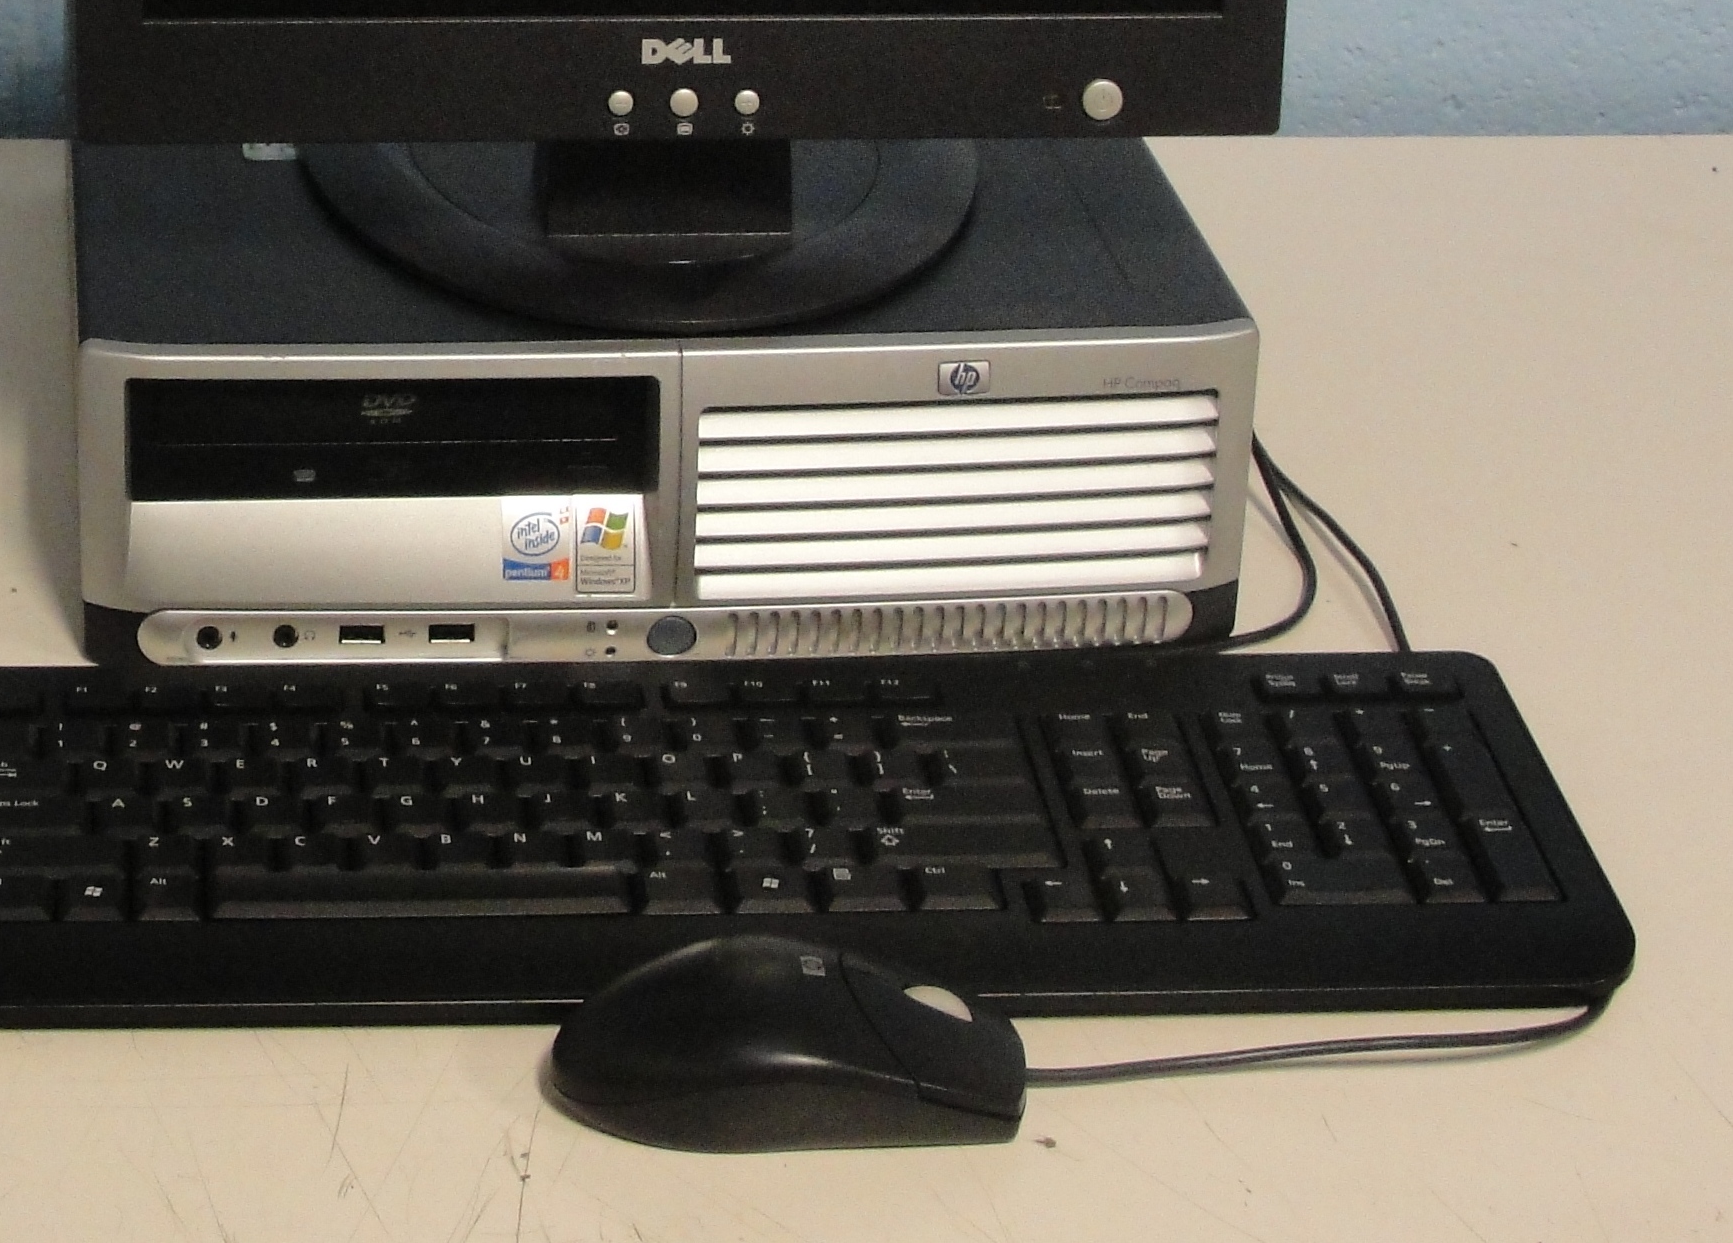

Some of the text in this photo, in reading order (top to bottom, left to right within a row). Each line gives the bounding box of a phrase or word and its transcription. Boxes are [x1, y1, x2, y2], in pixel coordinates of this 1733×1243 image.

[642, 38, 731, 65] DELL
[953, 363, 977, 394] hp
[517, 518, 540, 539] intel
[524, 530, 555, 550] inside
[506, 567, 548, 579] pentium
[896, 713, 953, 721] Backspace
[451, 757, 461, 766] Y
[520, 756, 531, 765] U
[662, 754, 675, 763] O
[733, 753, 742, 762] P
[94, 761, 107, 770] Q
[166, 760, 184, 769] W
[236, 759, 244, 768] E
[307, 758, 317, 767] R
[379, 758, 388, 767] T
[1251, 785, 1259, 793] 4
[472, 795, 484, 804] H
[545, 794, 551, 802] J
[615, 793, 627, 802] K
[687, 791, 695, 800] L
[112, 799, 124, 807] A
[183, 798, 192, 806] S
[256, 797, 268, 805] D
[328, 796, 335, 805] F
[401, 796, 412, 805] G
[877, 827, 904, 835] Shift
[368, 835, 380, 844] V
[441, 834, 451, 844] B
[514, 833, 526, 842] N
[587, 831, 602, 841] M
[149, 837, 159, 846] Z
[222, 837, 233, 846] X
[295, 836, 305, 846] C
